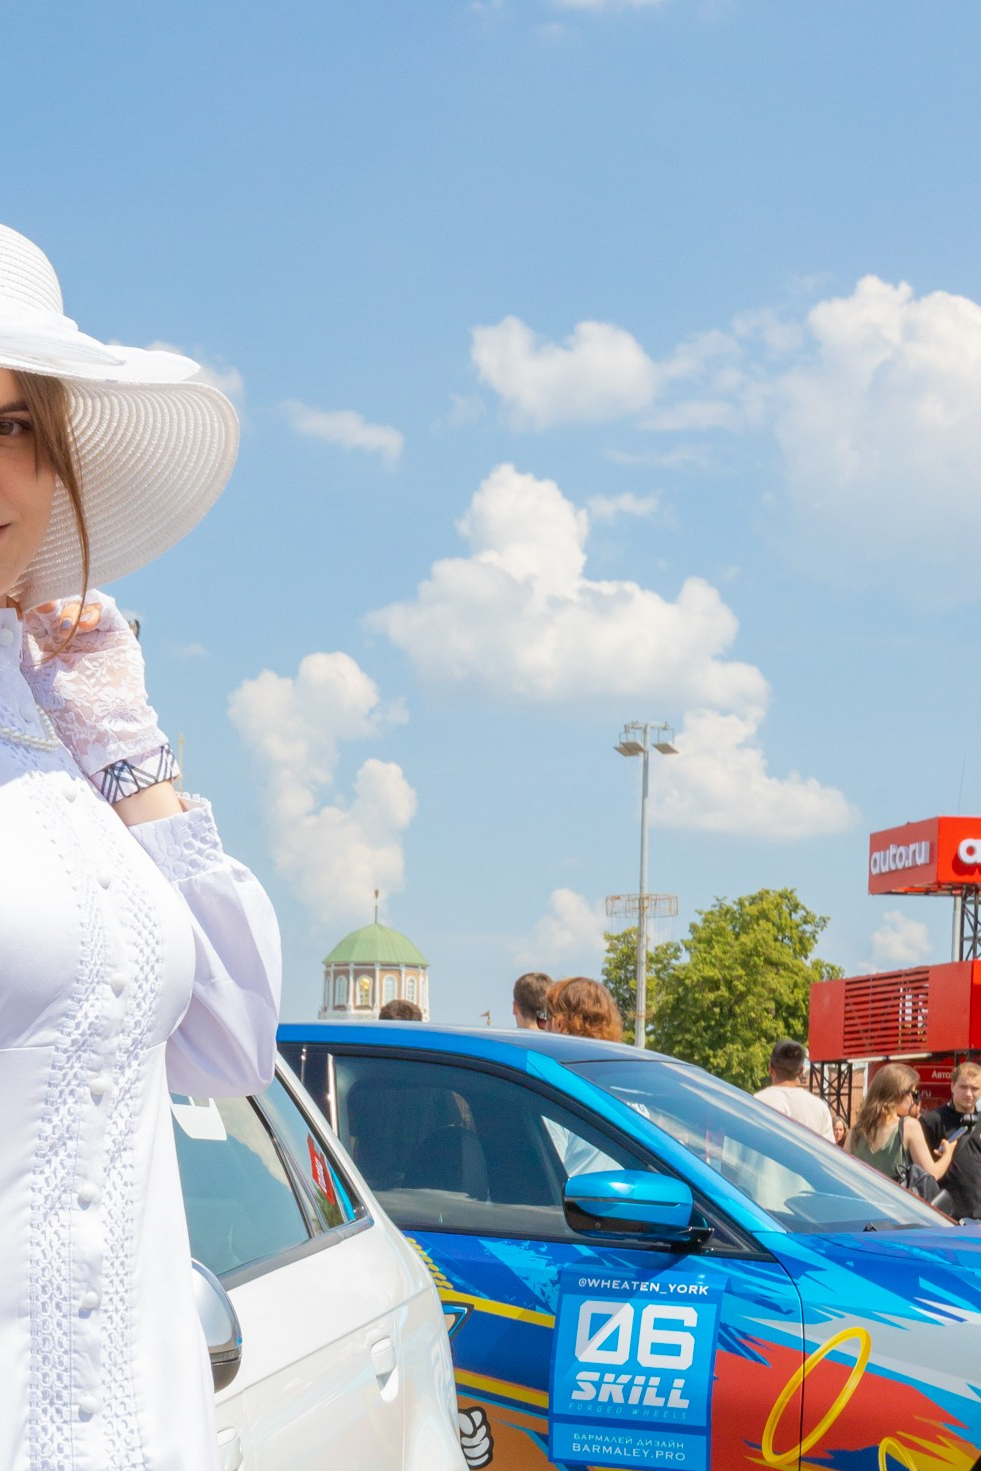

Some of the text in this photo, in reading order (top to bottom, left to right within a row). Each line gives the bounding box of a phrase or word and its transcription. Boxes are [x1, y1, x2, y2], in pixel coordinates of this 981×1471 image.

[870, 840, 930, 875] auto.ru
[578, 1278, 709, 1296] @WHEATEN_YORK
[575, 1300, 698, 1370] 06
[568, 1402, 688, 1420] FORGED WHEELS
[573, 1432, 685, 1450] БАРМАЛЕЙ ДИЗАЙН
[572, 1442, 686, 1461] BARMALEY.PRO
